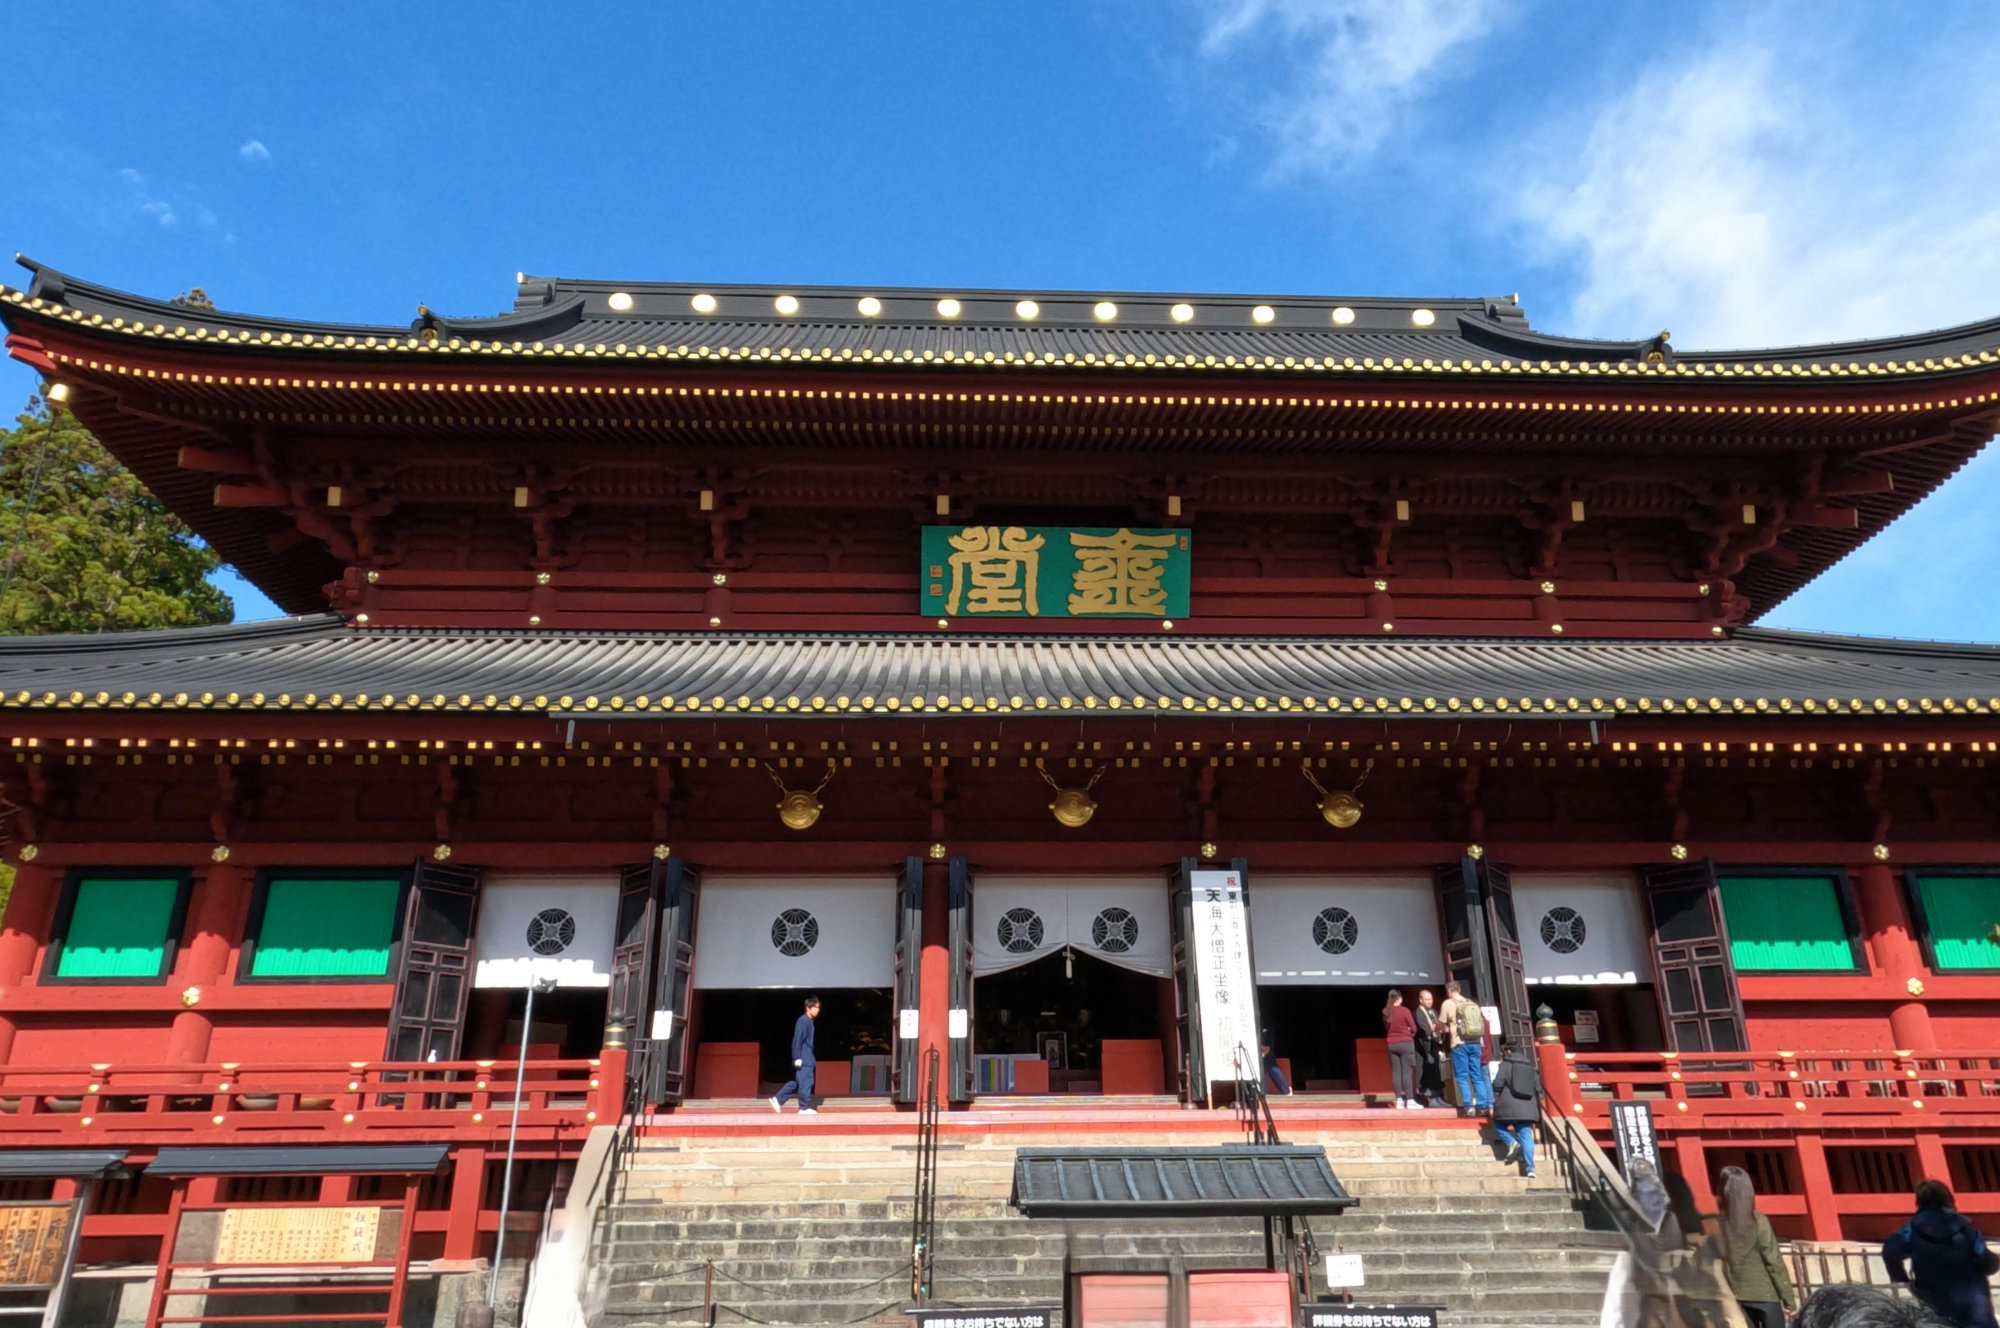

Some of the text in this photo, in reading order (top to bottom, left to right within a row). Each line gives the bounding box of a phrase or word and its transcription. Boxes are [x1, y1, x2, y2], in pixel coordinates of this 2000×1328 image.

[1205, 889, 1231, 1004] 天海大僧正坐像
